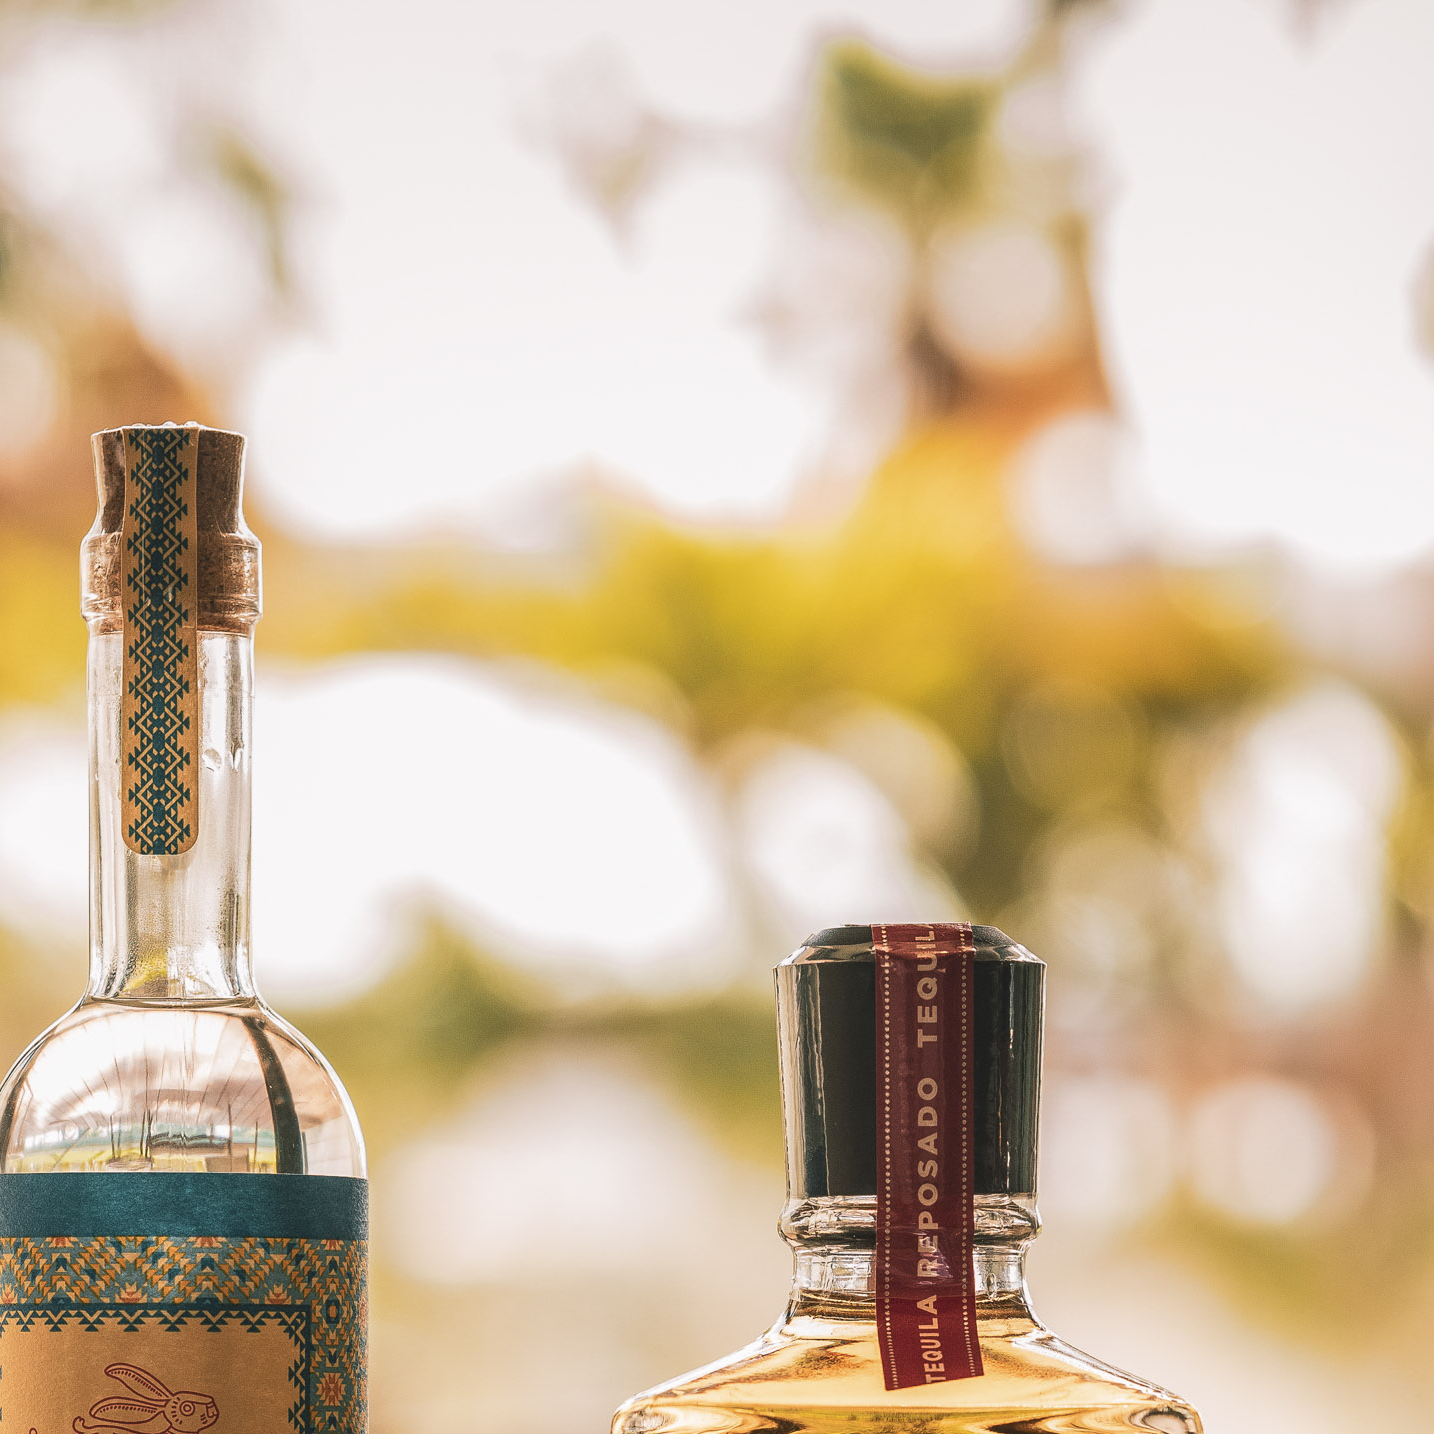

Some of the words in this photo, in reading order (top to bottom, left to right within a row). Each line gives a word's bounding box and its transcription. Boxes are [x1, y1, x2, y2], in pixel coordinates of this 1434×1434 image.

[915, 924, 938, 1048] TEQUIL
[916, 1077, 939, 1278] REPOSADO
[917, 1294, 946, 1384] TEQUILA
